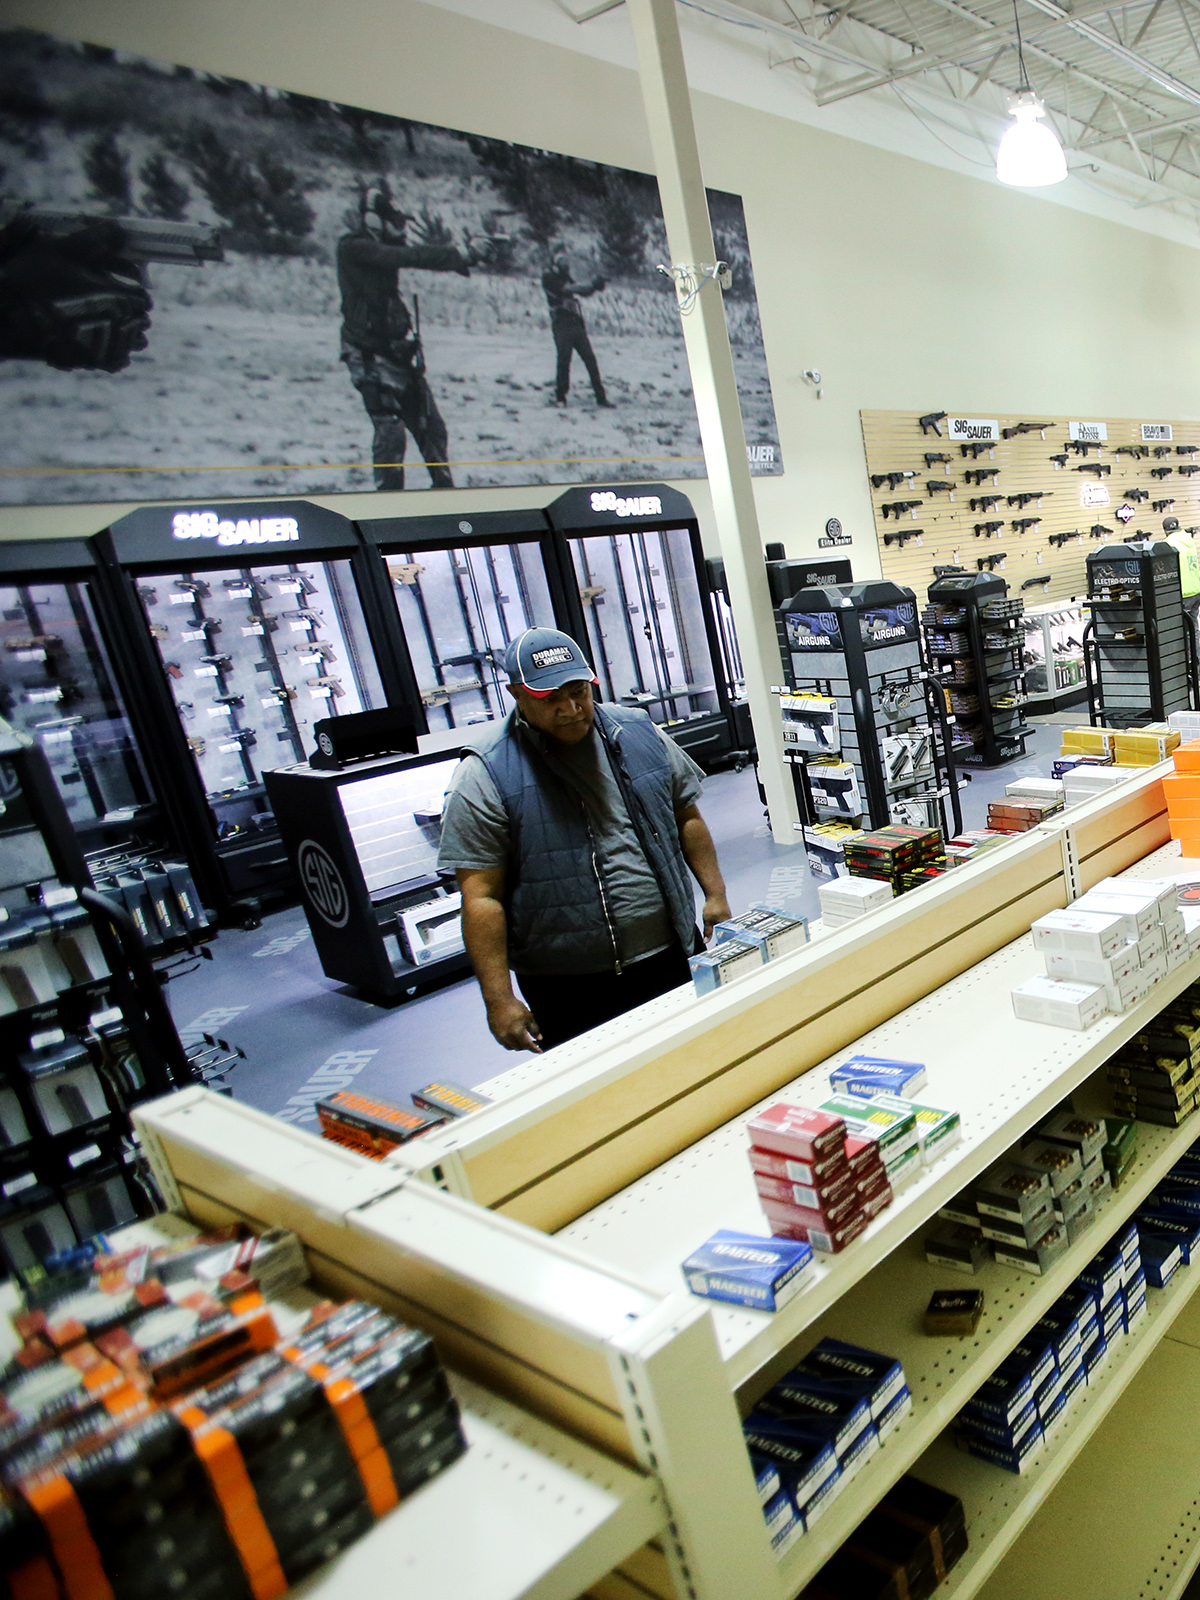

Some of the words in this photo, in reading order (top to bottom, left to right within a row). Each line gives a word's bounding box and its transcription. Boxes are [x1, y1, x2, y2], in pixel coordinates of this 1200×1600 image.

[954, 420, 968, 433] SIG
[967, 425, 992, 439] SAUER
[1078, 422, 1098, 433] DANIEL
[1078, 430, 1099, 440] DEFENSE
[1144, 425, 1160, 435] BRAVO
[746, 445, 774, 462] AUER
[590, 491, 617, 512] SIG
[615, 496, 663, 517] SAUER
[173, 512, 219, 539] SIG
[217, 517, 300, 547] SAUER
[820, 538, 833, 547] Elite
[834, 537, 851, 546] Dealer
[806, 573, 817, 584] SIG
[816, 574, 837, 586] SAUER
[1094, 577, 1140, 585] ELECTRO-OPTICS
[798, 636, 831, 646] AIRGUNS
[873, 626, 906, 641] AIRGUNS
[532, 647, 569, 661] DURAMAX
[544, 655, 566, 665] DIESEL
[305, 852, 341, 916] SIG
[850, 1062, 903, 1075] MAGTECH
[850, 1083, 895, 1097] MAGTECH
[331, 1091, 426, 1130] MINISHELL
[866, 1110, 898, 1126] UMC
[914, 1110, 943, 1124] UMC
[1143, 1217, 1189, 1233] MAGTECH
[711, 1244, 781, 1265] MAGTECH
[774, 1251, 811, 1290] MAGTECH
[708, 1279, 767, 1300] MAGTECH
[817, 1353, 875, 1377] MAGTECH
[781, 1388, 839, 1414] MAGTECH
[746, 1432, 803, 1462] MAGTECH
